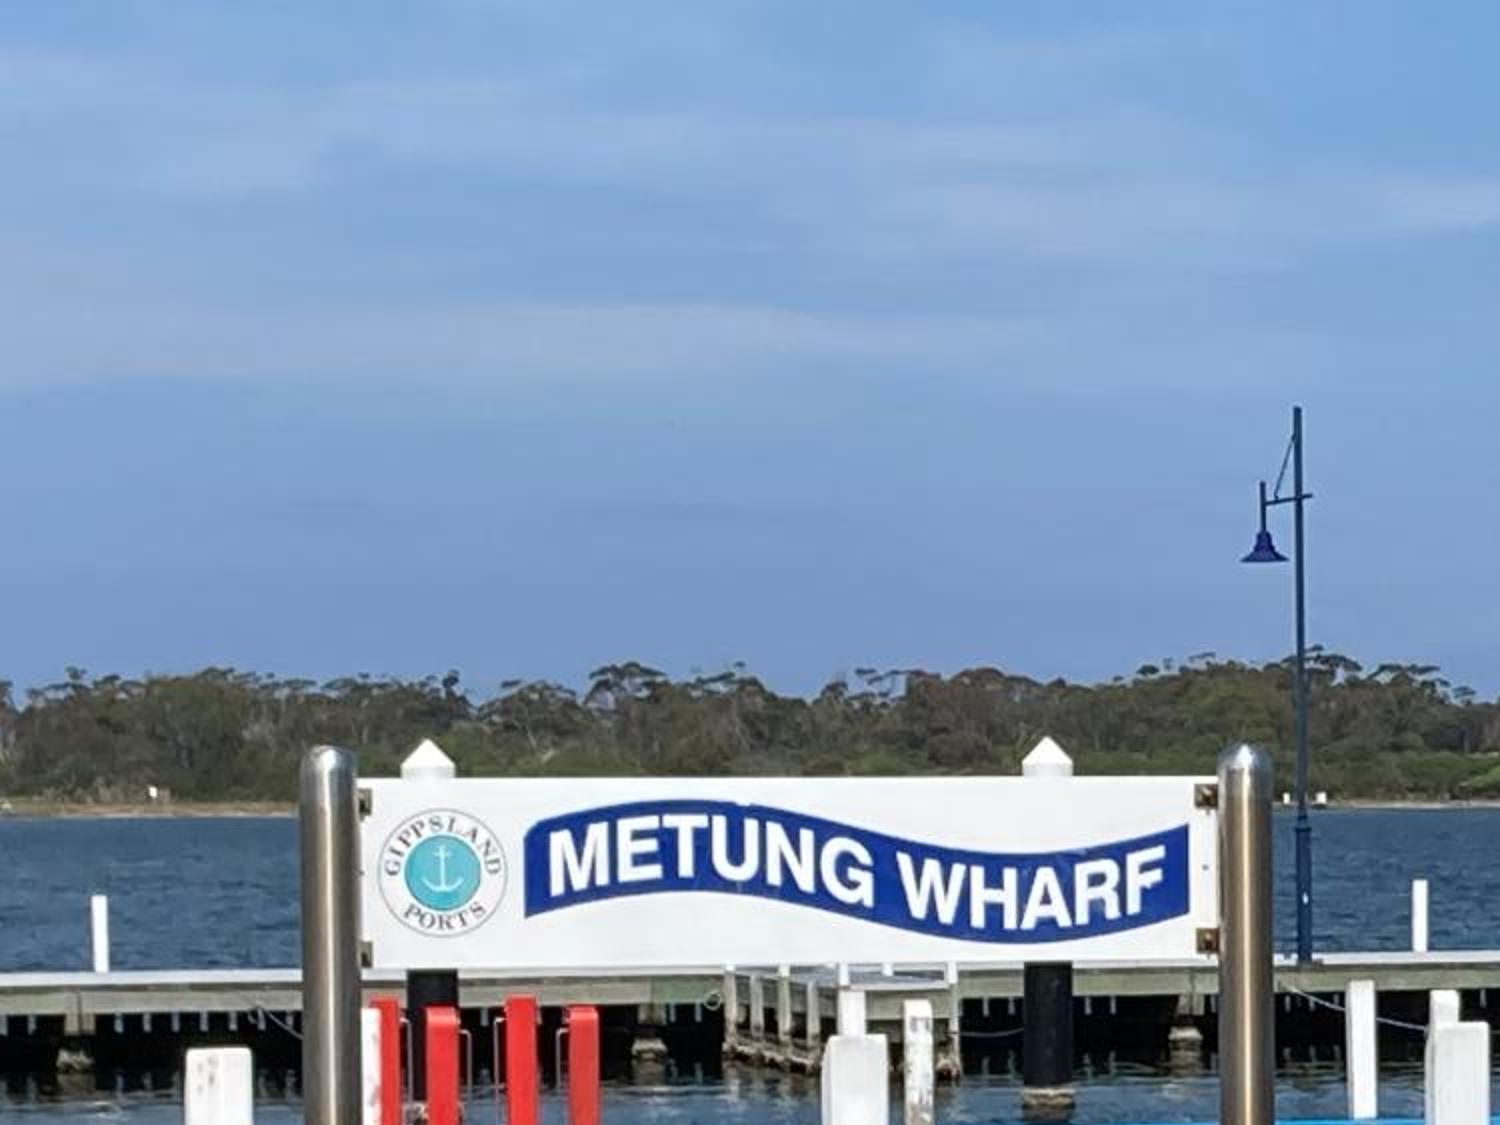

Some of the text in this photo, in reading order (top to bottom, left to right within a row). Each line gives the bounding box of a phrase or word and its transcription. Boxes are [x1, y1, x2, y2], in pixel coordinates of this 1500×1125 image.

[548, 814, 1166, 932] METUNG WHARF
[404, 901, 486, 930] PORTS
